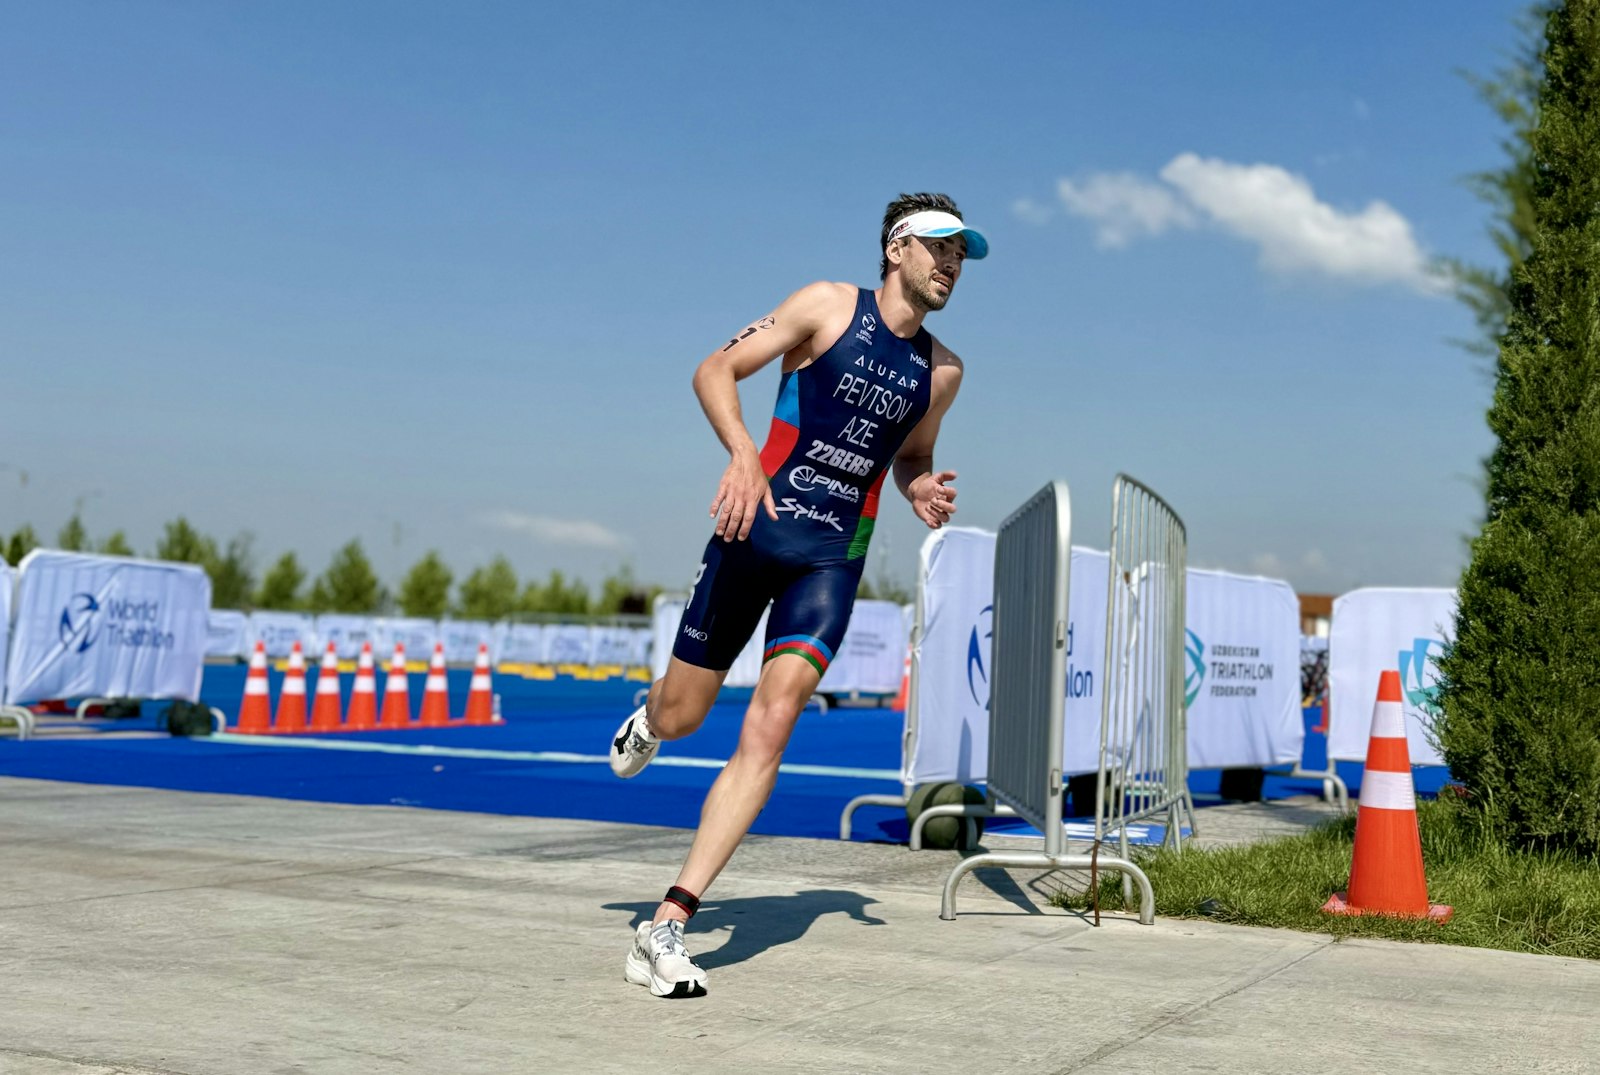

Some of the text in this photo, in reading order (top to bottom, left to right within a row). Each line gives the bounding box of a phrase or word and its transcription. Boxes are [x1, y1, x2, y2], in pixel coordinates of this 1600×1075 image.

[854, 354, 919, 392] ALUFAR
[832, 372, 913, 424] PEVTSOV
[837, 415, 879, 449] AZE
[805, 439, 875, 477] 226ERS
[775, 497, 844, 532] Spiuk
[108, 598, 158, 622] World
[106, 625, 175, 649] Triathlon
[1211, 644, 1260, 658] UZBEKISTAN
[1210, 660, 1274, 680] TRIATHLON
[1210, 685, 1257, 697] FEDERATION
